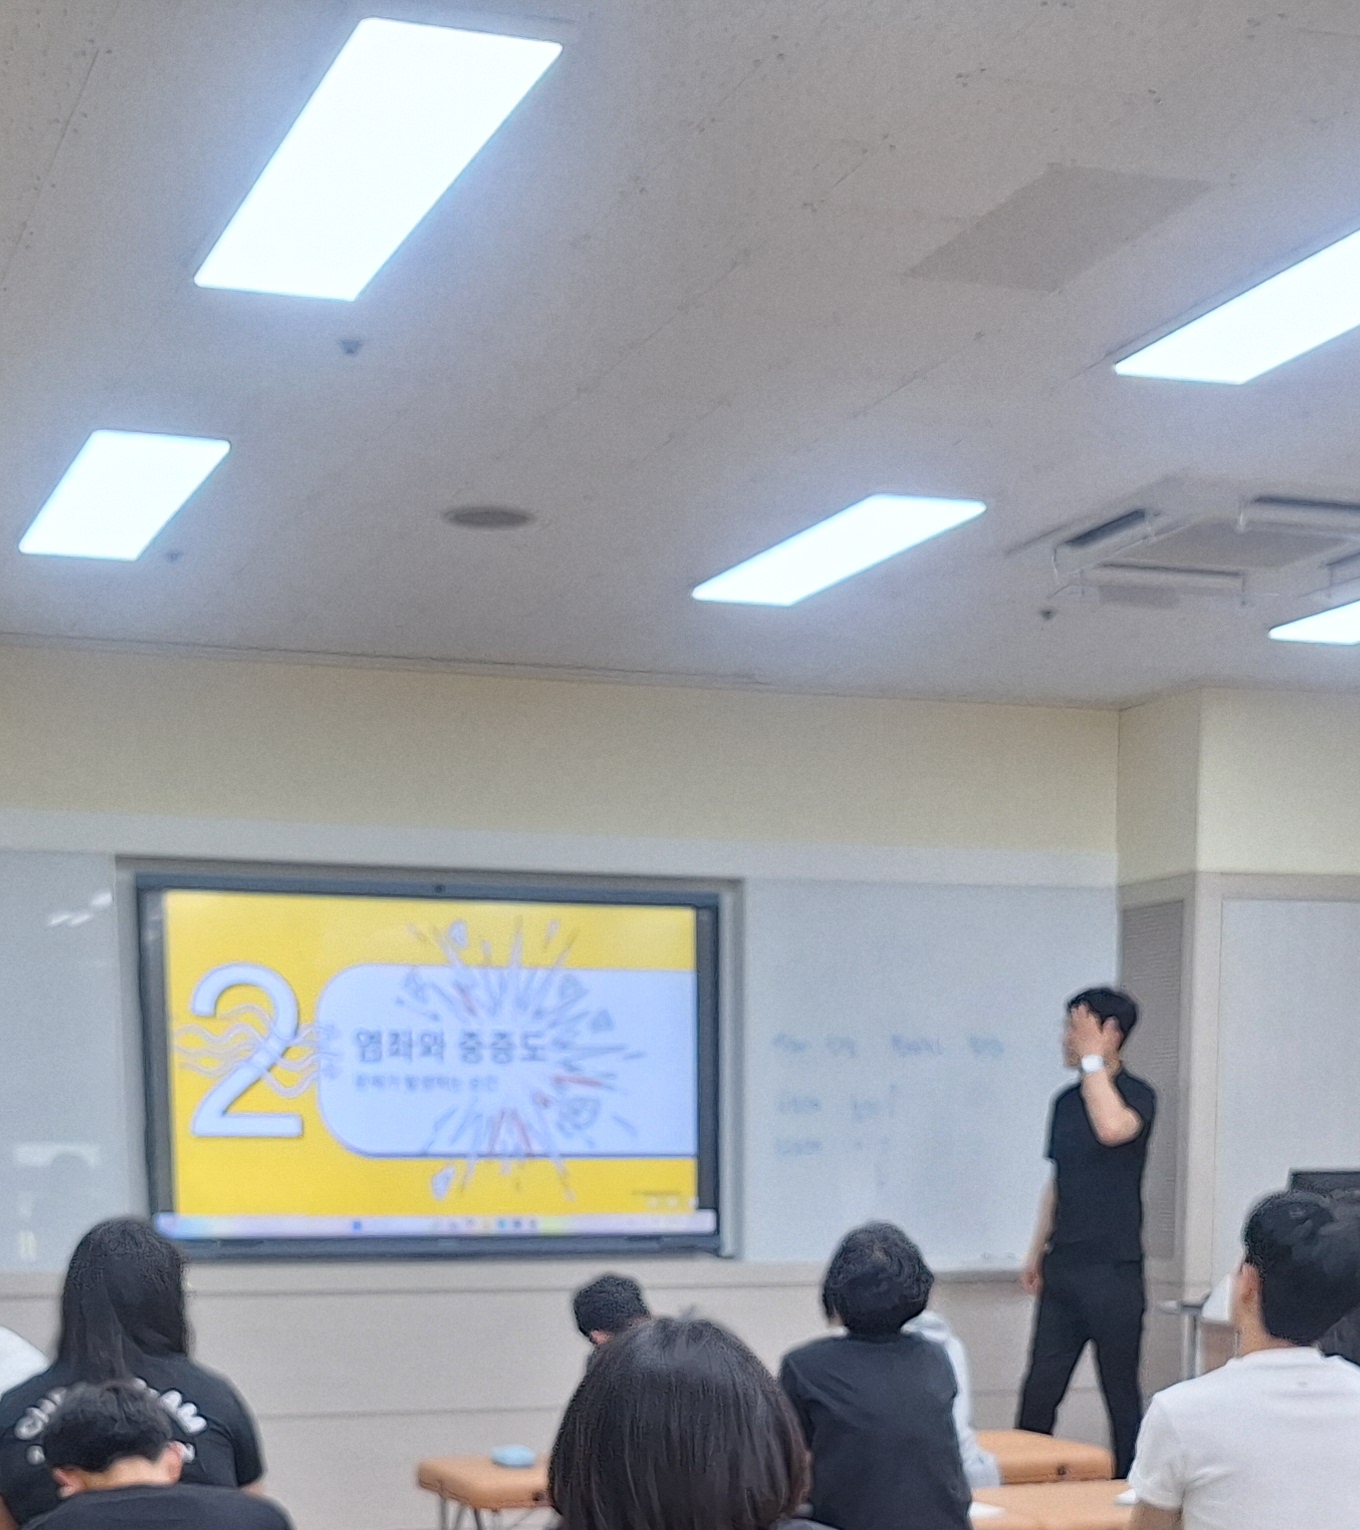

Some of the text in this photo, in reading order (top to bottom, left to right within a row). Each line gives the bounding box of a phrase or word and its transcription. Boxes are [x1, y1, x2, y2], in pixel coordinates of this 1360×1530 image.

[189, 962, 303, 1138] 2
[355, 1030, 547, 1064] 염좌와 중증도
